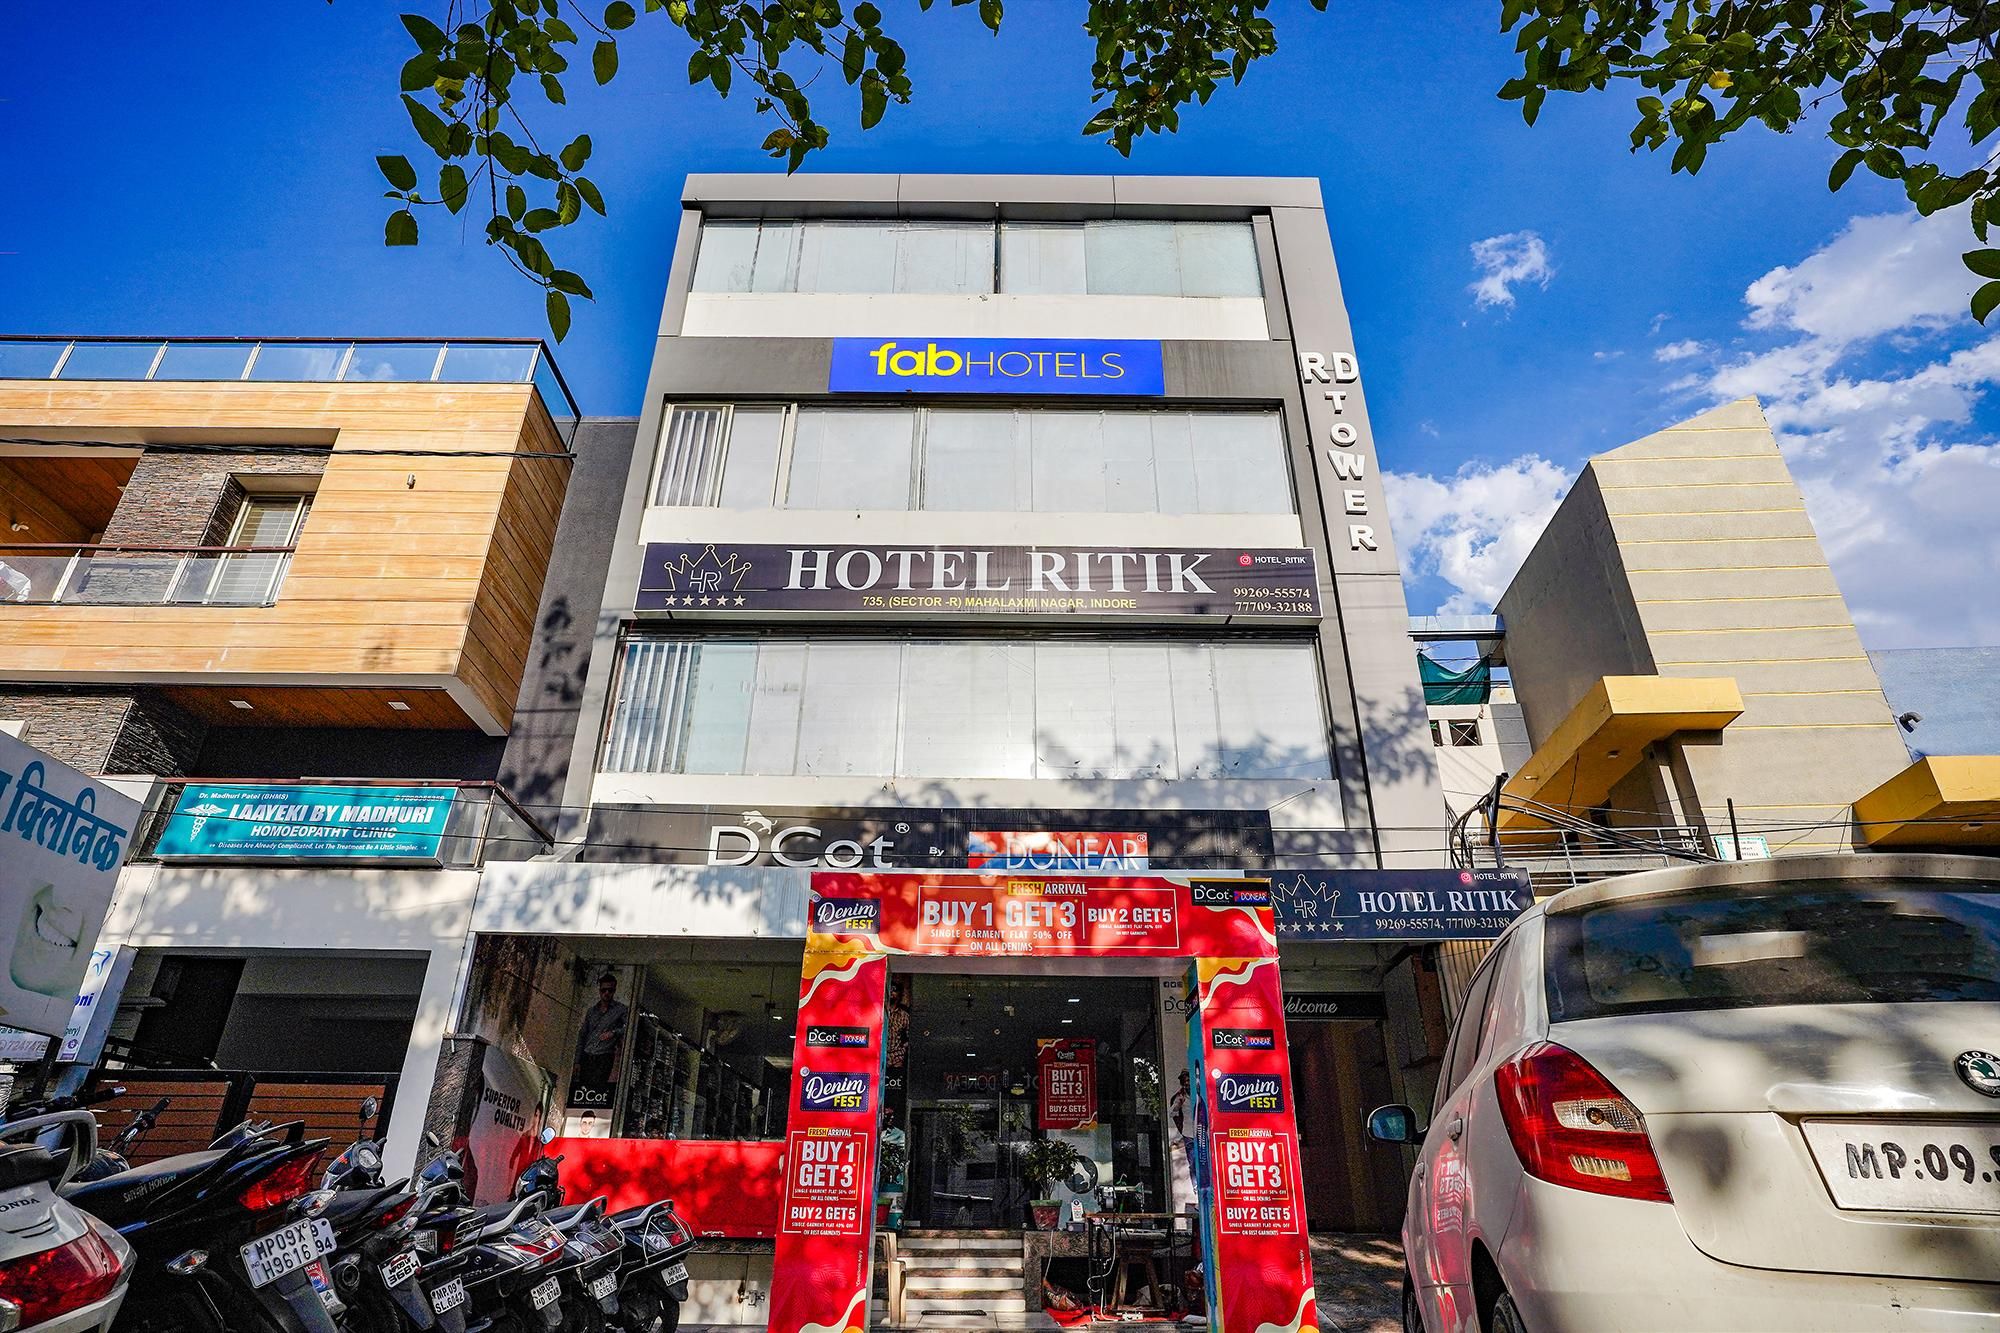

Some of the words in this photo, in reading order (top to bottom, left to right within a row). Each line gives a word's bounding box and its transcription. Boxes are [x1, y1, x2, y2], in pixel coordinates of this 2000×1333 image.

[1300, 352, 1359, 384] RD
[1324, 391, 1378, 551] TOWER
[1255, 556, 1307, 567] HOTEL_RITIK
[783, 549, 1011, 591] HOTEL
[1026, 551, 1217, 594] RITIK
[1233, 587, 1311, 599] 99269-55574
[862, 597, 885, 608] 735,
[888, 597, 942, 609] (SECTOR
[945, 597, 962, 609] -R)
[965, 597, 1038, 609] MAHALAXMI
[1091, 599, 1137, 609] INDORE
[1235, 601, 1313, 613] 77709-32188
[199, 792, 208, 800] Dr.
[1, 761, 128, 872] क्लिनिक
[228, 804, 309, 821] LAAYEKI
[309, 805, 339, 822] BY
[339, 805, 435, 823] MADHURI
[250, 825, 349, 838] HOMOEOPATHY
[352, 827, 398, 838] CLINIC
[928, 846, 945, 858] By
[1005, 837, 1138, 870] DONEAR
[1473, 872, 1519, 881] HOTEL_RITIK
[1010, 884, 1041, 895] FRESH
[1044, 884, 1088, 895] ARRIVAL
[1357, 891, 1444, 913] HOTEL
[1448, 890, 1521, 912] RITIK
[817, 902, 877, 923] Denim
[924, 900, 977, 926] BUY
[981, 902, 993, 926] 1
[1005, 900, 1057, 927] GET
[1088, 909, 1117, 923] BUY
[1120, 909, 1129, 923] 2
[1133, 909, 1160, 923] GET
[845, 919, 874, 930] FEST
[1446, 917, 1510, 929] 77709-32188
[930, 929, 961, 939] SINGLE
[965, 930, 1005, 939] GARMENT
[1009, 930, 1028, 939] FLAT
[1033, 930, 1052, 939] 50%
[1057, 930, 1072, 939] OFF
[970, 942, 982, 951] ON
[985, 942, 999, 951] ALL
[1001, 942, 1033, 952] DENIMS
[1052, 1070, 1075, 1082] BUY
[1076, 1070, 1082, 1082] 1
[805, 1076, 866, 1100] Denim
[1052, 1082, 1075, 1095] GET
[1075, 1082, 1083, 1095] 3
[1220, 1078, 1280, 1101] Denim
[484, 1087, 521, 1115] SUPERIOR
[834, 1096, 862, 1108] FEST
[1250, 1097, 1277, 1109] FEST
[1049, 1105, 1062, 1113] BUY
[1062, 1105, 1068, 1113] 2
[1069, 1105, 1082, 1113] GET
[494, 1108, 527, 1132] QUALITY
[828, 1129, 851, 1137] ARRIVAL
[1230, 1129, 1248, 1137] FRESH
[1249, 1129, 1273, 1137] ARRIVAL
[802, 1141, 843, 1162] BUY
[845, 1142, 855, 1163] 1
[1226, 1142, 1266, 1163] BUY
[1268, 1142, 1279, 1163] 1
[799, 1163, 839, 1187] GET
[1228, 1164, 1267, 1187] GET
[0, 1198, 40, 1212] ONDA
[791, 1206, 815, 1219] BUY
[815, 1207, 822, 1220] 2
[826, 1206, 848, 1220] GET
[1226, 1207, 1248, 1220] BUY
[1250, 1207, 1257, 1220] 2
[1260, 1207, 1282, 1220] GET
[262, 1244, 311, 1280] H9616
[388, 1260, 418, 1285] 3684
[436, 1282, 458, 1300] MP.09
